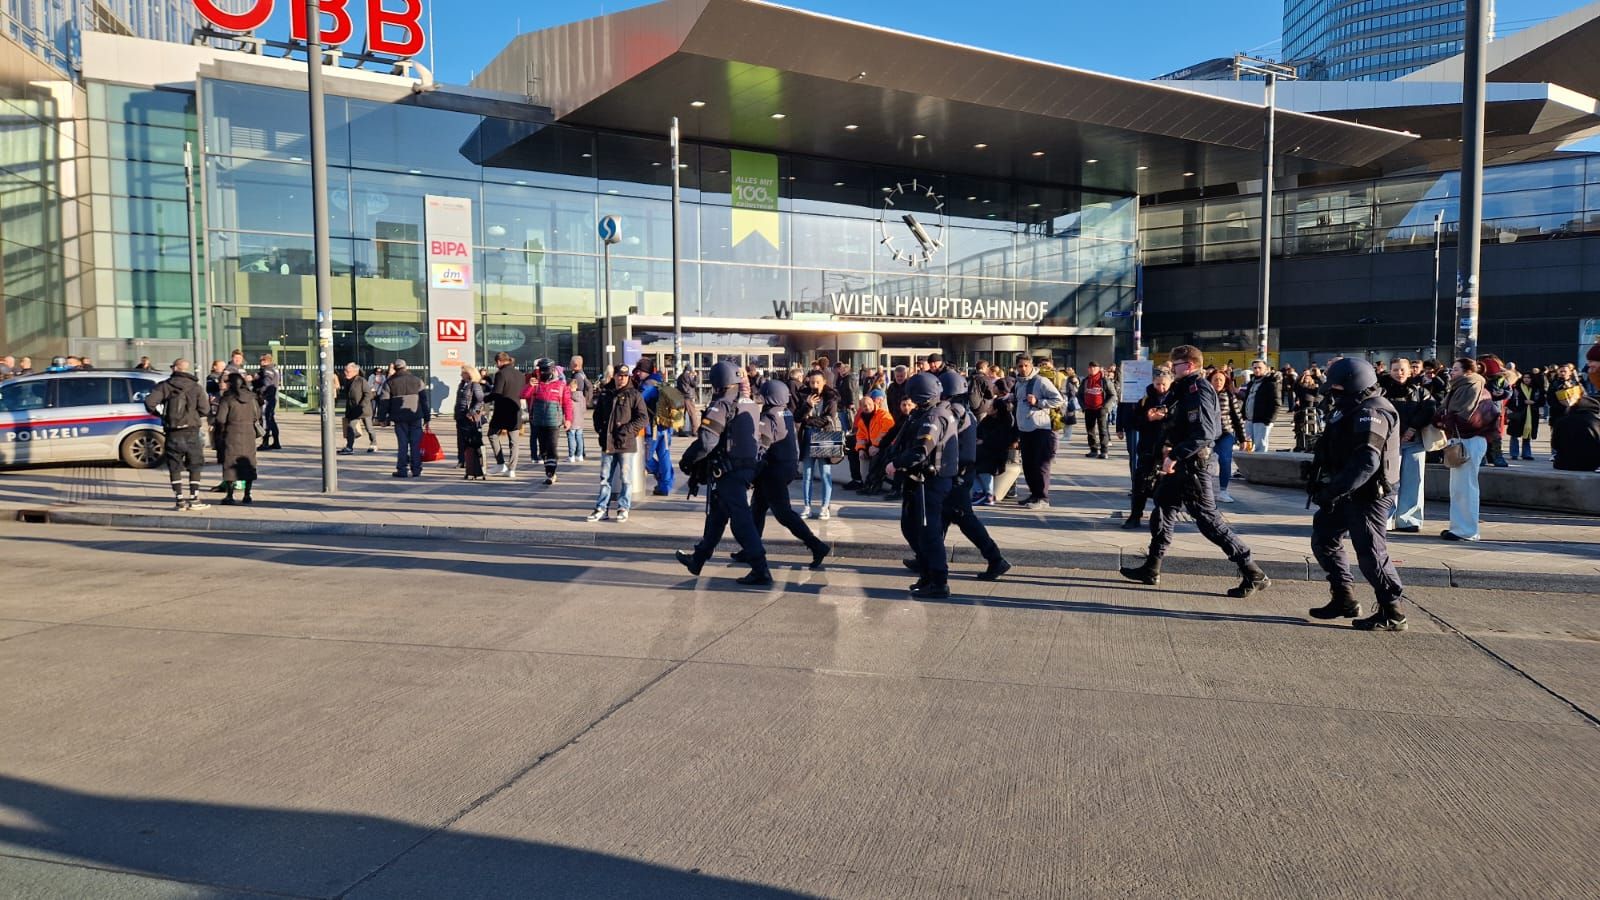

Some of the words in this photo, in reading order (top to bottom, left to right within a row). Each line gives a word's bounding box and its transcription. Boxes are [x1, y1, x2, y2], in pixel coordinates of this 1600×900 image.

[735, 176, 757, 184] ALLES
[760, 178, 774, 186] MIT
[431, 240, 468, 257] BIPA
[443, 267, 462, 279] dm
[831, 293, 887, 315] WIEN
[895, 295, 1048, 321] HAUPTBAHNHOF
[439, 321, 466, 336] IN
[6, 427, 78, 442] POLIZEI
